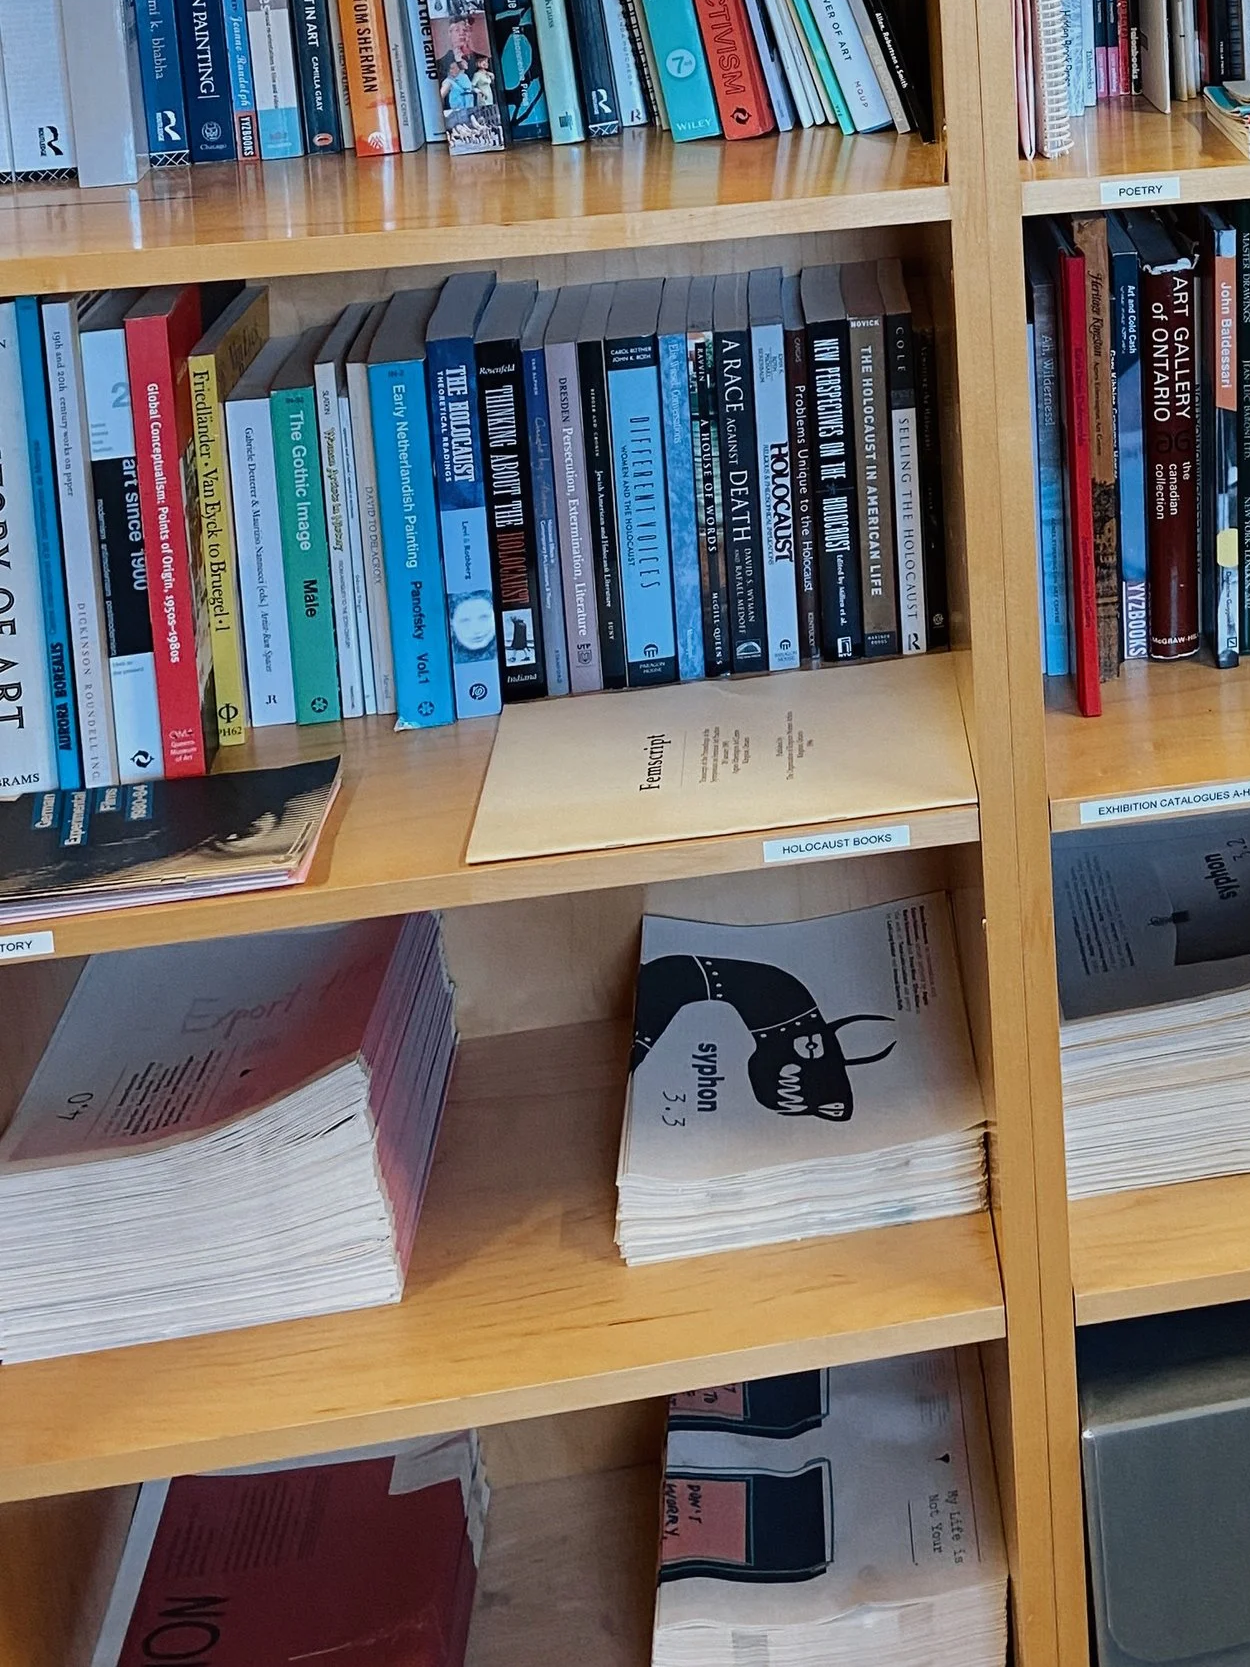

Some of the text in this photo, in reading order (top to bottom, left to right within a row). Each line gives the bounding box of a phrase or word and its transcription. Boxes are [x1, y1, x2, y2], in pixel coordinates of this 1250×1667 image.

[193, 11, 214, 94] PAINTING
[1119, 184, 1162, 196] POETRY
[1152, 302, 1171, 422] of ONTARIO
[1172, 277, 1191, 419] ART GALLERY
[1221, 282, 1233, 388] John Baldessari
[289, 411, 304, 442] The
[393, 384, 406, 417] Early
[445, 365, 475, 482] THE HOLOCAUST
[559, 377, 570, 422] DRESDEN
[292, 442, 309, 498] Gothic
[395, 422, 413, 512] Netherlandish
[1155, 464, 1165, 520] collection
[1169, 464, 1178, 515] canadian
[296, 503, 311, 551] Image
[769, 442, 794, 563] HOLOCAUST
[899, 418, 918, 620] SELLING THE HOLOCAUST
[403, 516, 418, 569] Painting
[411, 581, 429, 640] Panofsky
[1127, 582, 1147, 657] YYZBOOKS
[640, 733, 671, 792] Femscript
[35, 793, 55, 829] German
[64, 791, 86, 846] Experimental
[100, 788, 117, 813] Films
[1098, 787, 1250, 816] EXHIBITION CATALOGUES A-H
[782, 833, 893, 855] HOLOCAUST BOOKS
[1204, 852, 1239, 900] syphon
[692, 1042, 725, 1112] syphon
[662, 1090, 686, 1127] 3.3
[928, 1494, 943, 1554] Not Your
[948, 1489, 965, 1565] My Life is
